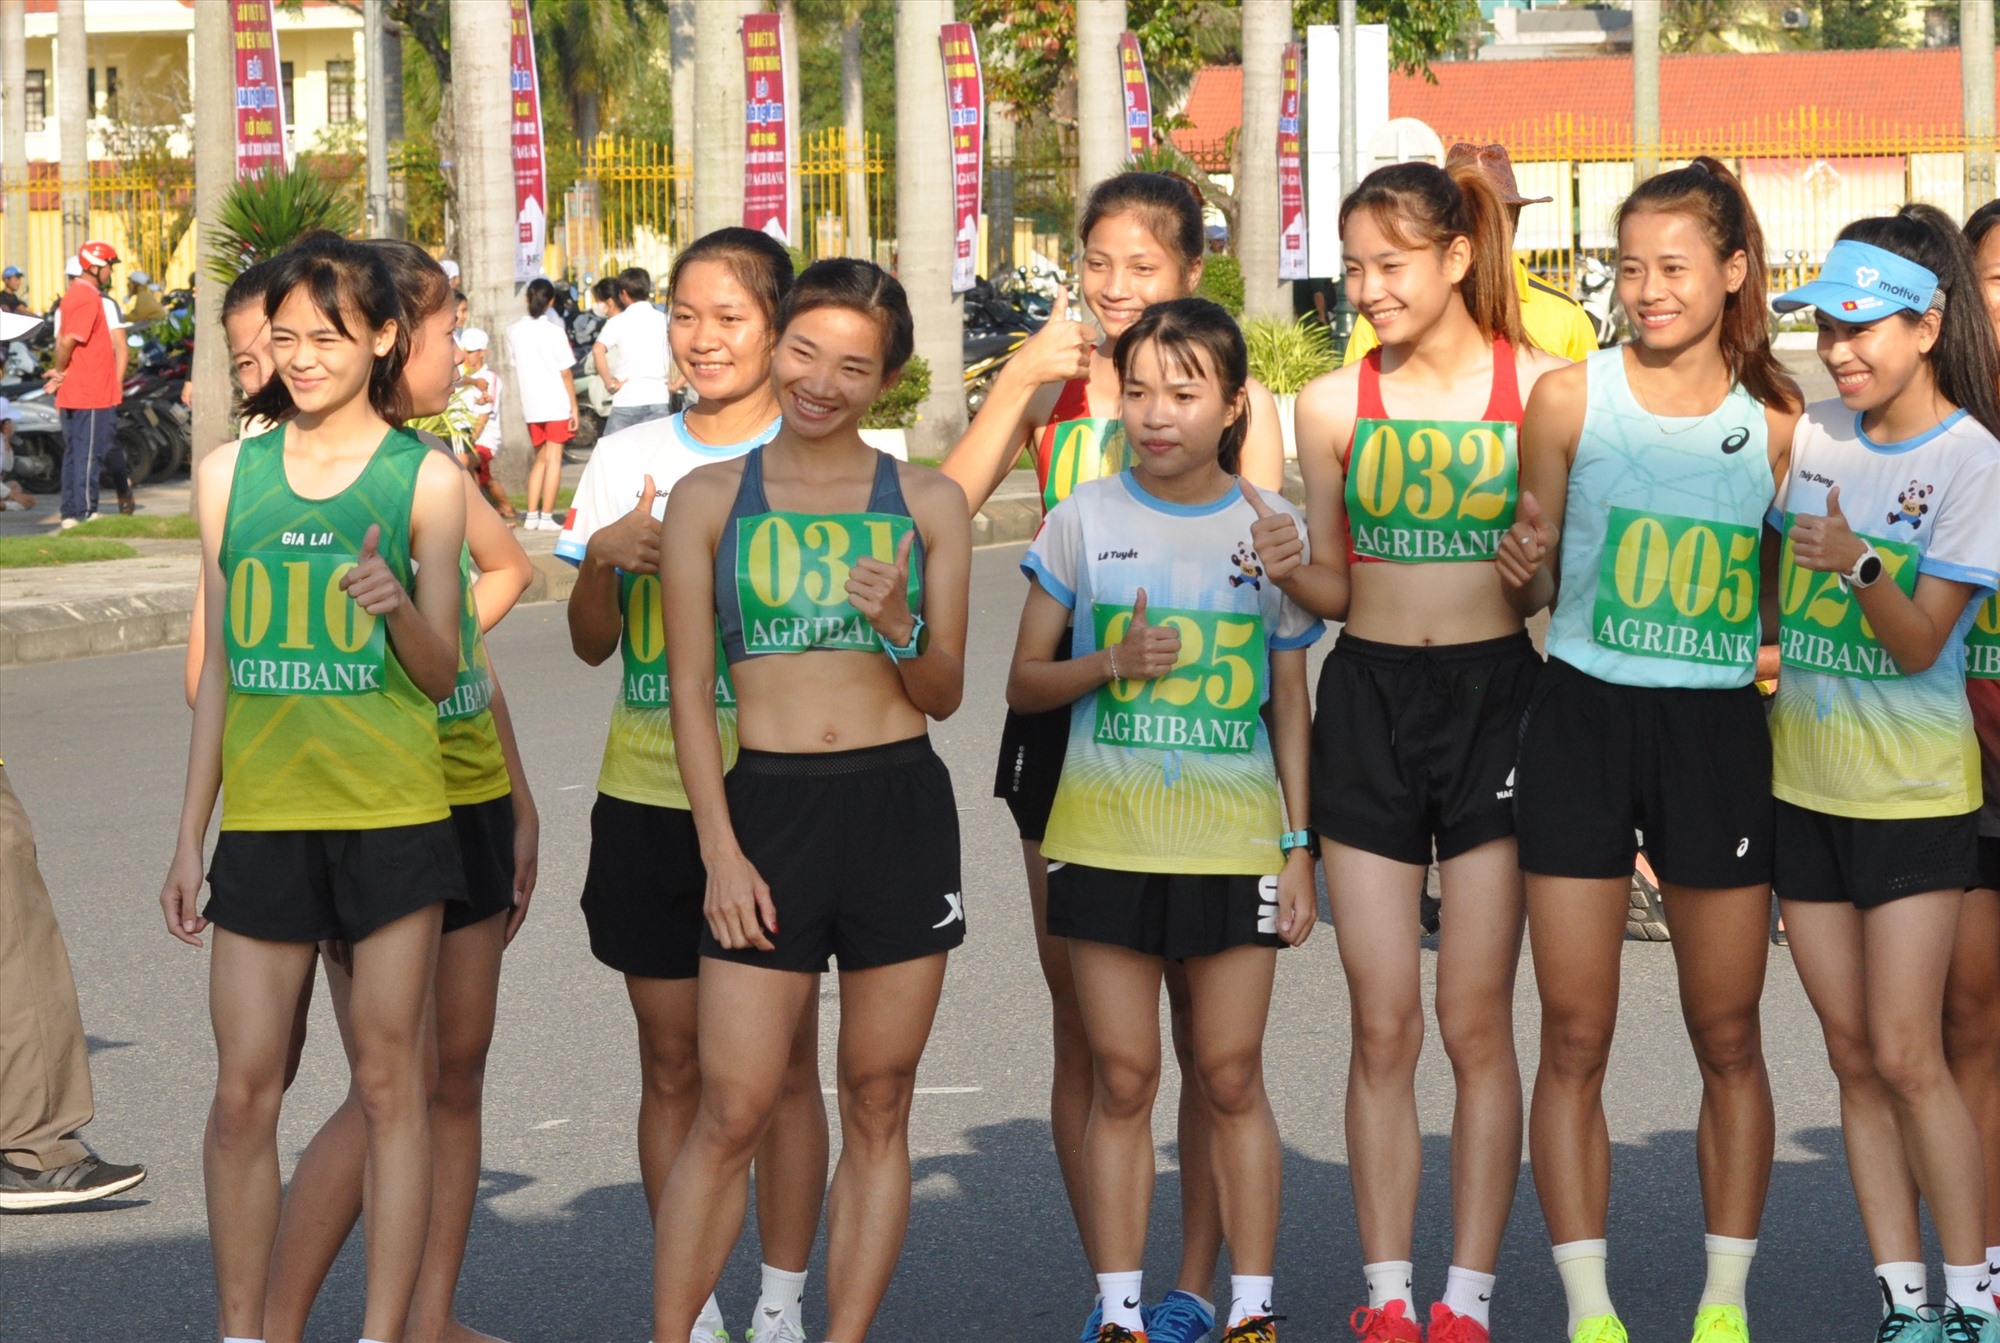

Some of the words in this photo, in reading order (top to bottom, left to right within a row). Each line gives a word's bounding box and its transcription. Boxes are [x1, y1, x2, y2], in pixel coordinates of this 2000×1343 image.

[1879, 281, 1922, 304] motive
[1356, 424, 1507, 522] 032
[281, 532, 305, 546] GIA
[310, 532, 333, 546] LAI
[1614, 517, 1756, 624] 005
[230, 557, 377, 653] 010
[1598, 614, 1754, 664] AGRIBANK
[1104, 611, 1255, 710] 025
[1097, 711, 1252, 750] AGRIBANK
